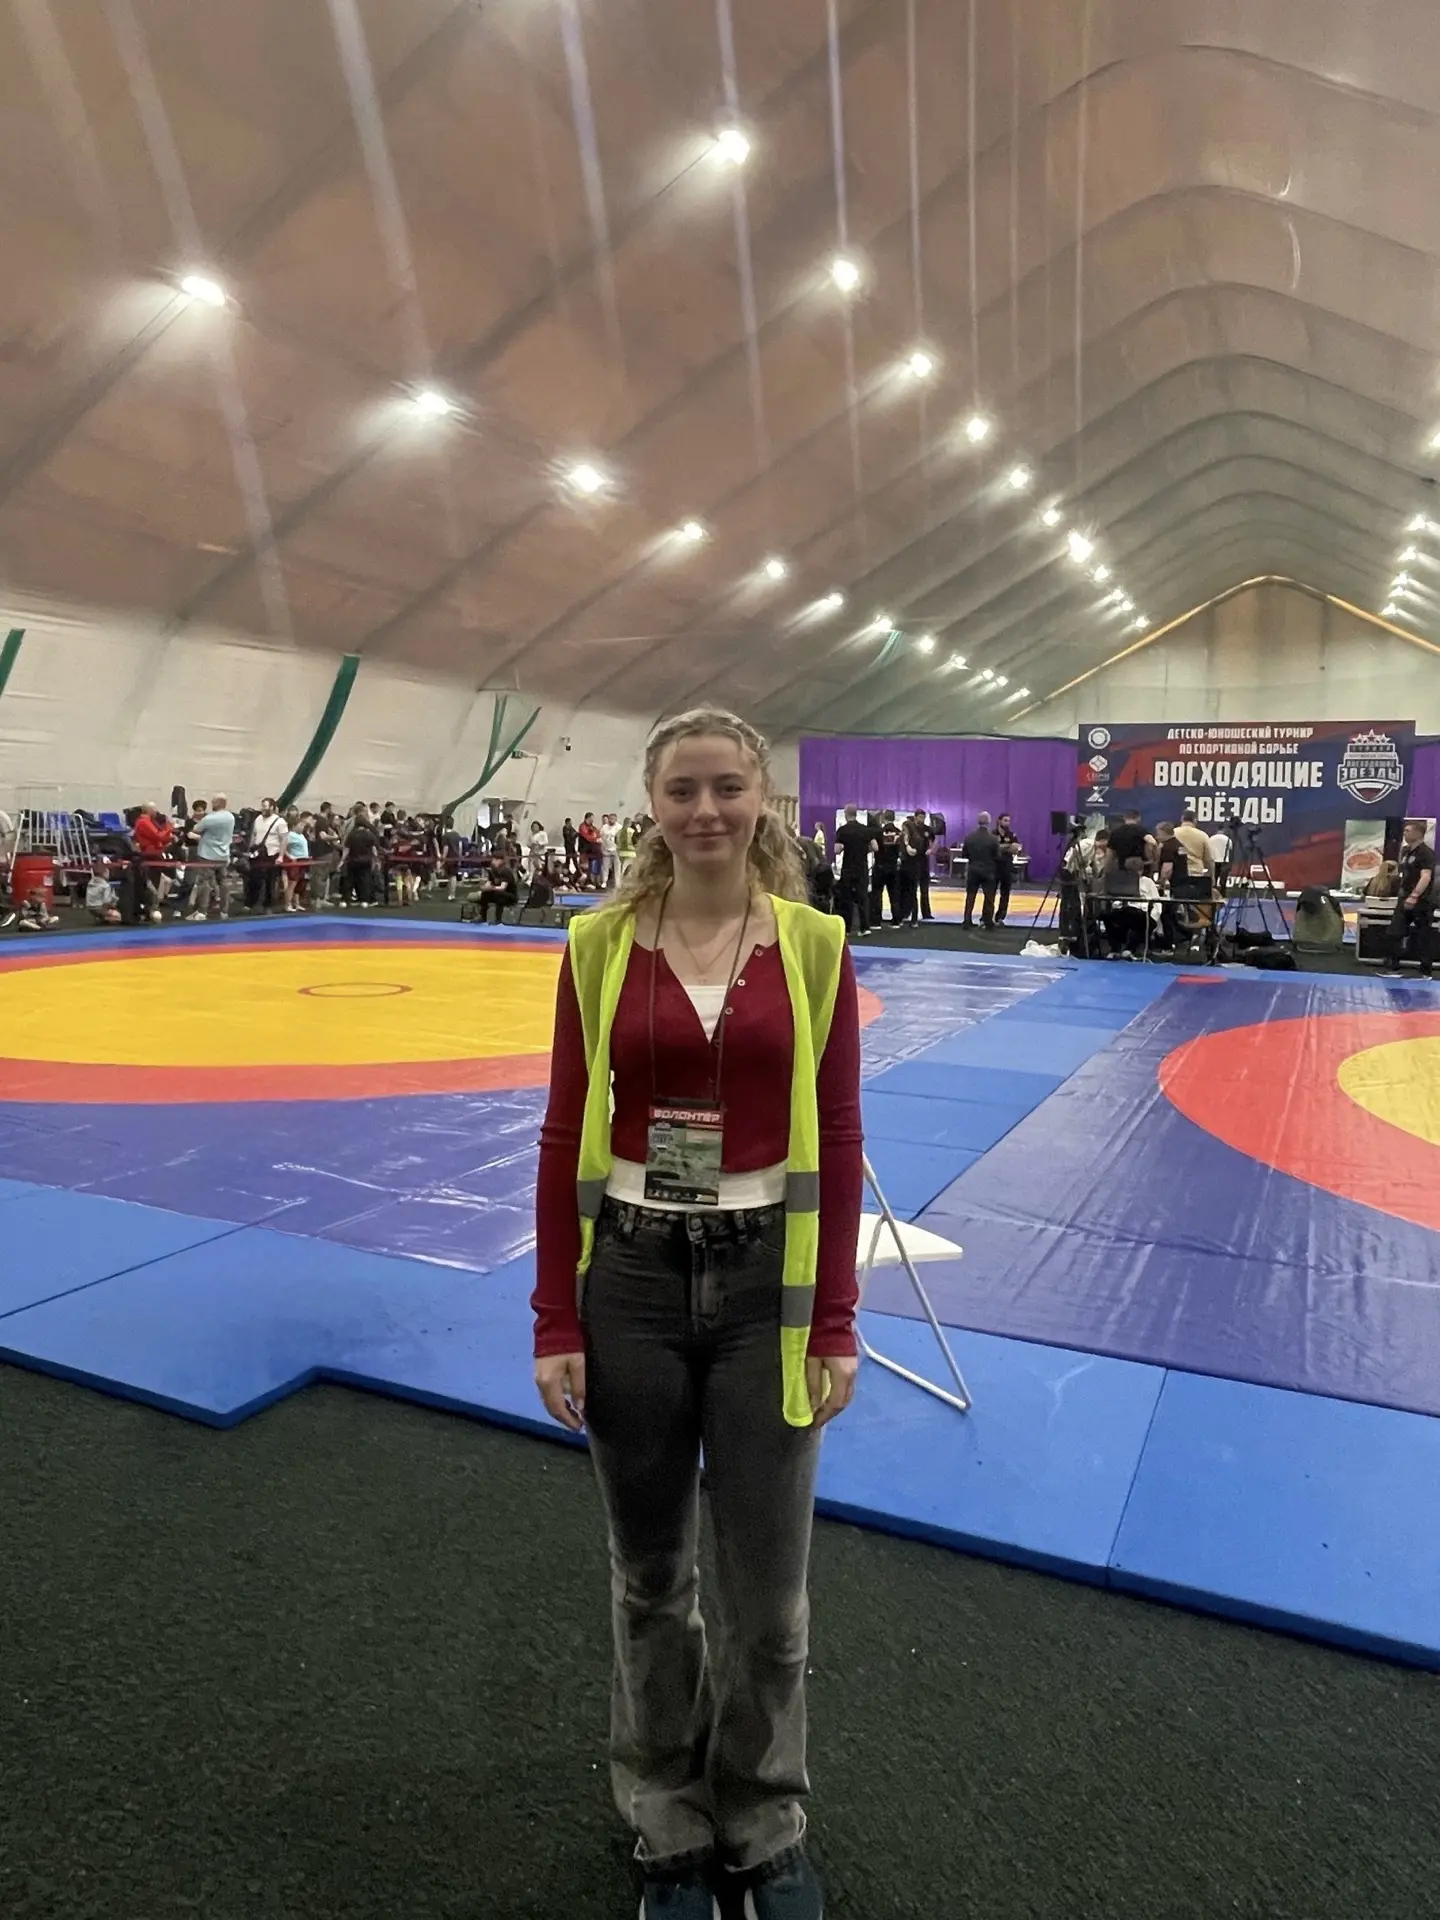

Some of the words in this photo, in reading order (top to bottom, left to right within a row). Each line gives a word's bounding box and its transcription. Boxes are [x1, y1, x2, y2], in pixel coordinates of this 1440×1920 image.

[1167, 726, 1271, 740] ДЕТСКО-ЮНОШЕСКИЙ
[1274, 727, 1313, 739] ТУРНИР
[1179, 744, 1192, 754] ПО
[1194, 742, 1257, 755] СПОРТИВНОЙ
[1259, 743, 1299, 754] БОРЬБЕ
[1154, 761, 1323, 789] ВОСХОДЯЩИЕ
